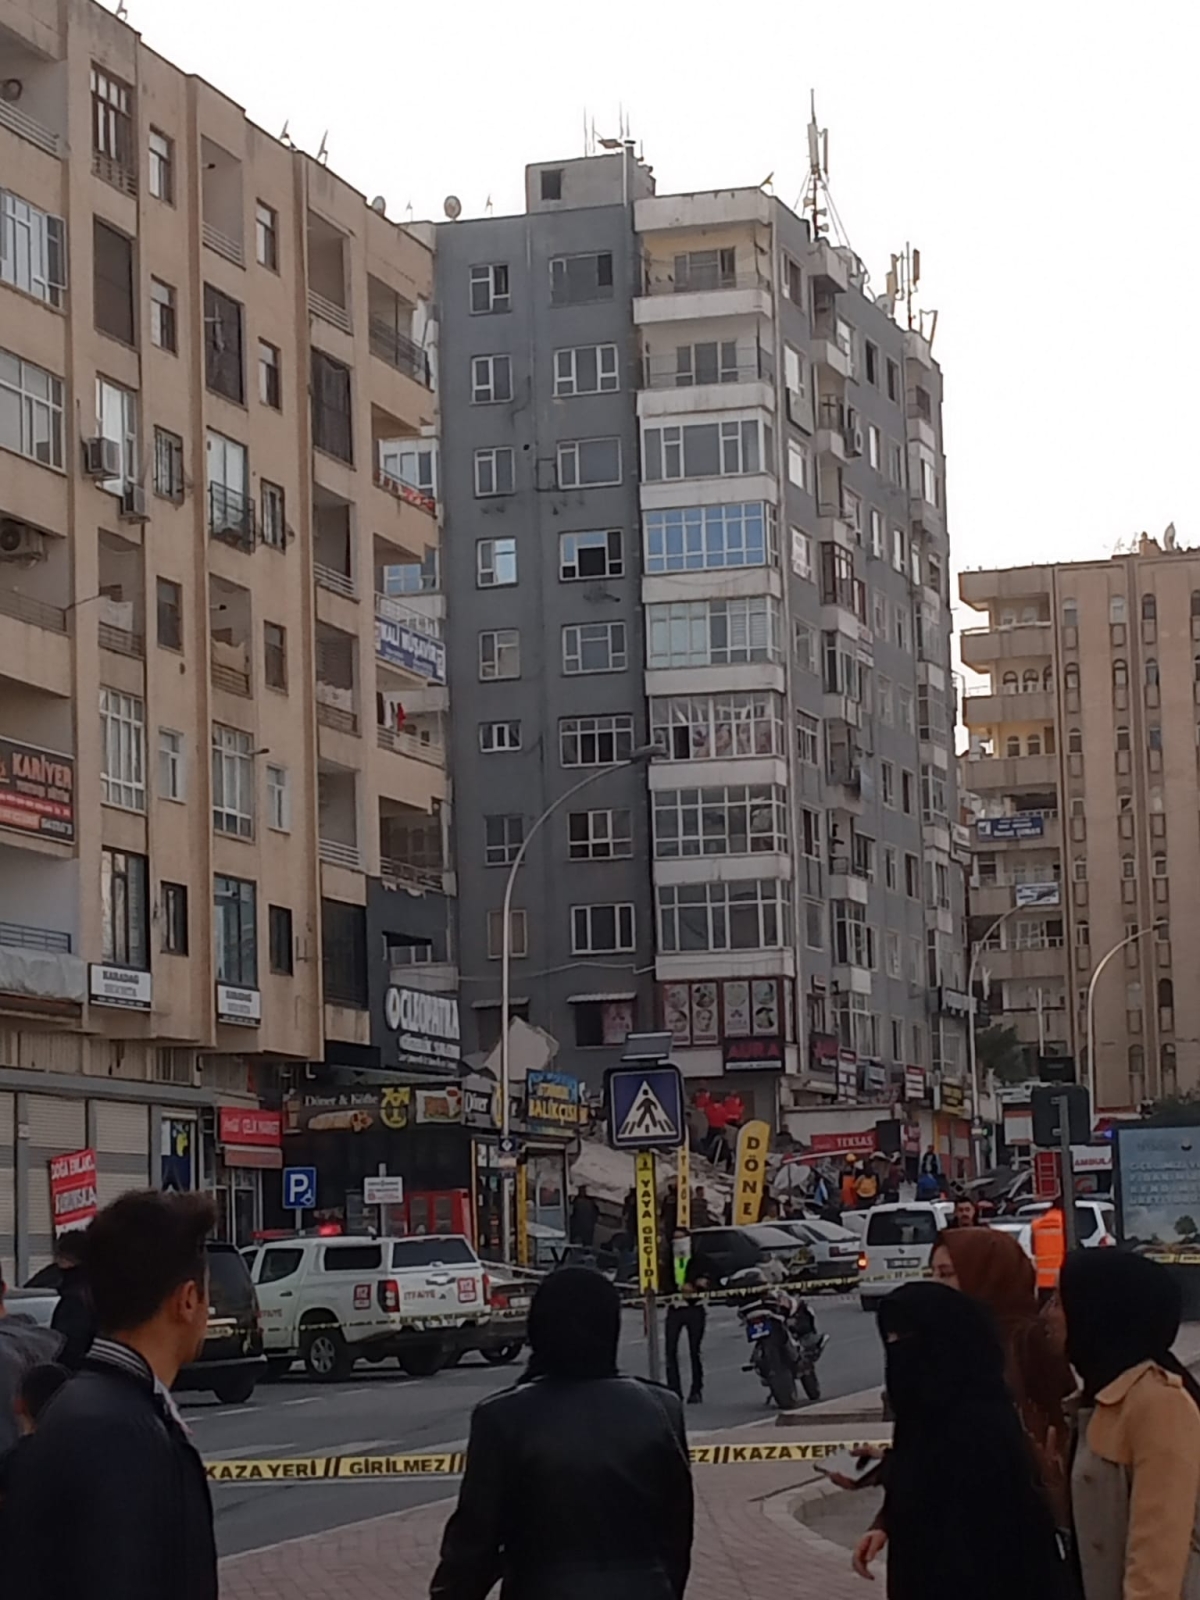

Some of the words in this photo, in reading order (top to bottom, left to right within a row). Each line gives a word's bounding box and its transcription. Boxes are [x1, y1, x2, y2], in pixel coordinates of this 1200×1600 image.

[305, 1095, 338, 1107] Döner
[290, 1174, 309, 1203] P
[640, 1179, 652, 1219] YAYA
[733, 1446, 791, 1461] KAZA
[799, 1443, 845, 1458] YER
[205, 1464, 261, 1479] KAZA
[267, 1460, 317, 1477] YERİ
[349, 1457, 446, 1475] GİRİLMEZ
